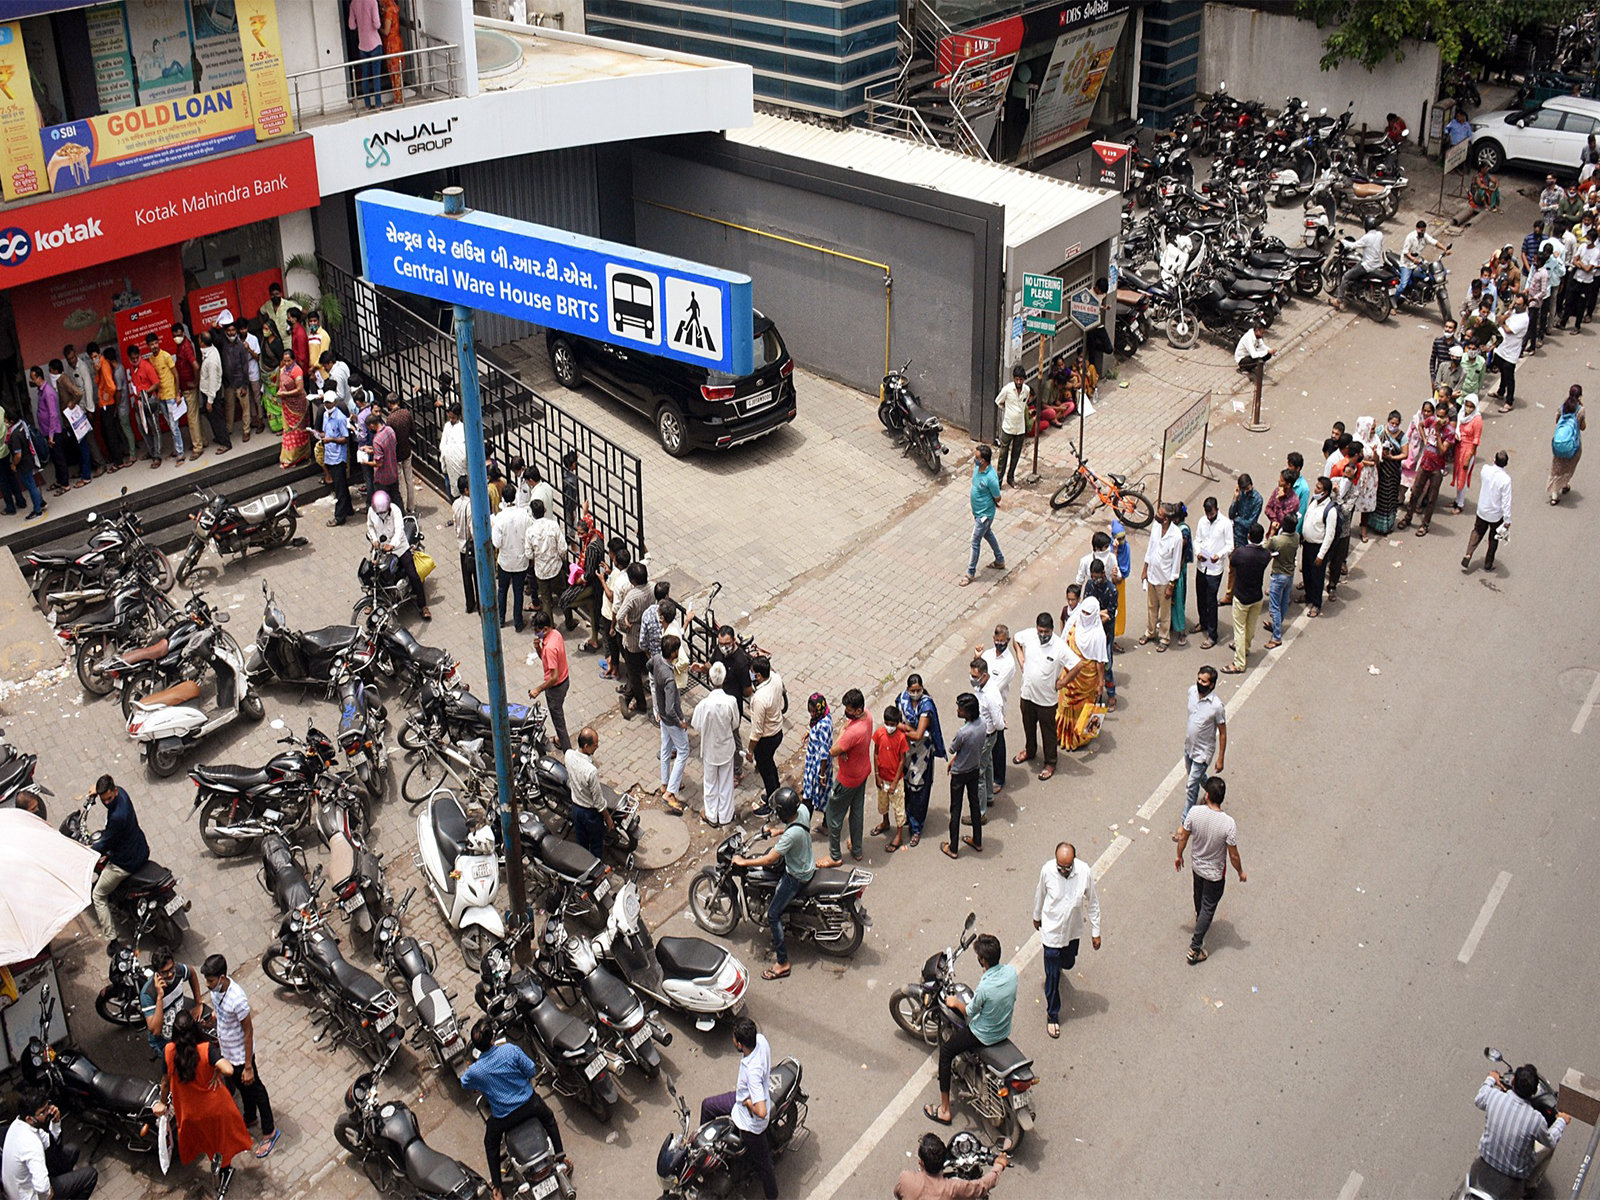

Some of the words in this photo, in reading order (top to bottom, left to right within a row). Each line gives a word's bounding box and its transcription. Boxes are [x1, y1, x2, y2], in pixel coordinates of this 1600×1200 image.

[1065, 6, 1081, 24] DBS
[107, 104, 170, 137] GOLD
[172, 90, 233, 122] LOAN
[60, 125, 77, 139] SBI
[407, 137, 453, 155] GROUP
[134, 200, 179, 226] Kotak
[182, 185, 251, 214] Mahindra
[254, 173, 289, 196] Bank
[34, 216, 104, 252] kotak
[426, 229, 447, 256] વેર
[450, 239, 486, 264] હાઉસ
[393, 256, 449, 287] Central
[452, 271, 495, 296] Ware
[499, 281, 552, 313] House
[556, 294, 599, 324] BRTS
[1025, 276, 1033, 287] NO
[1033, 277, 1061, 290] LITTERING
[1031, 288, 1053, 300] PLEASE
